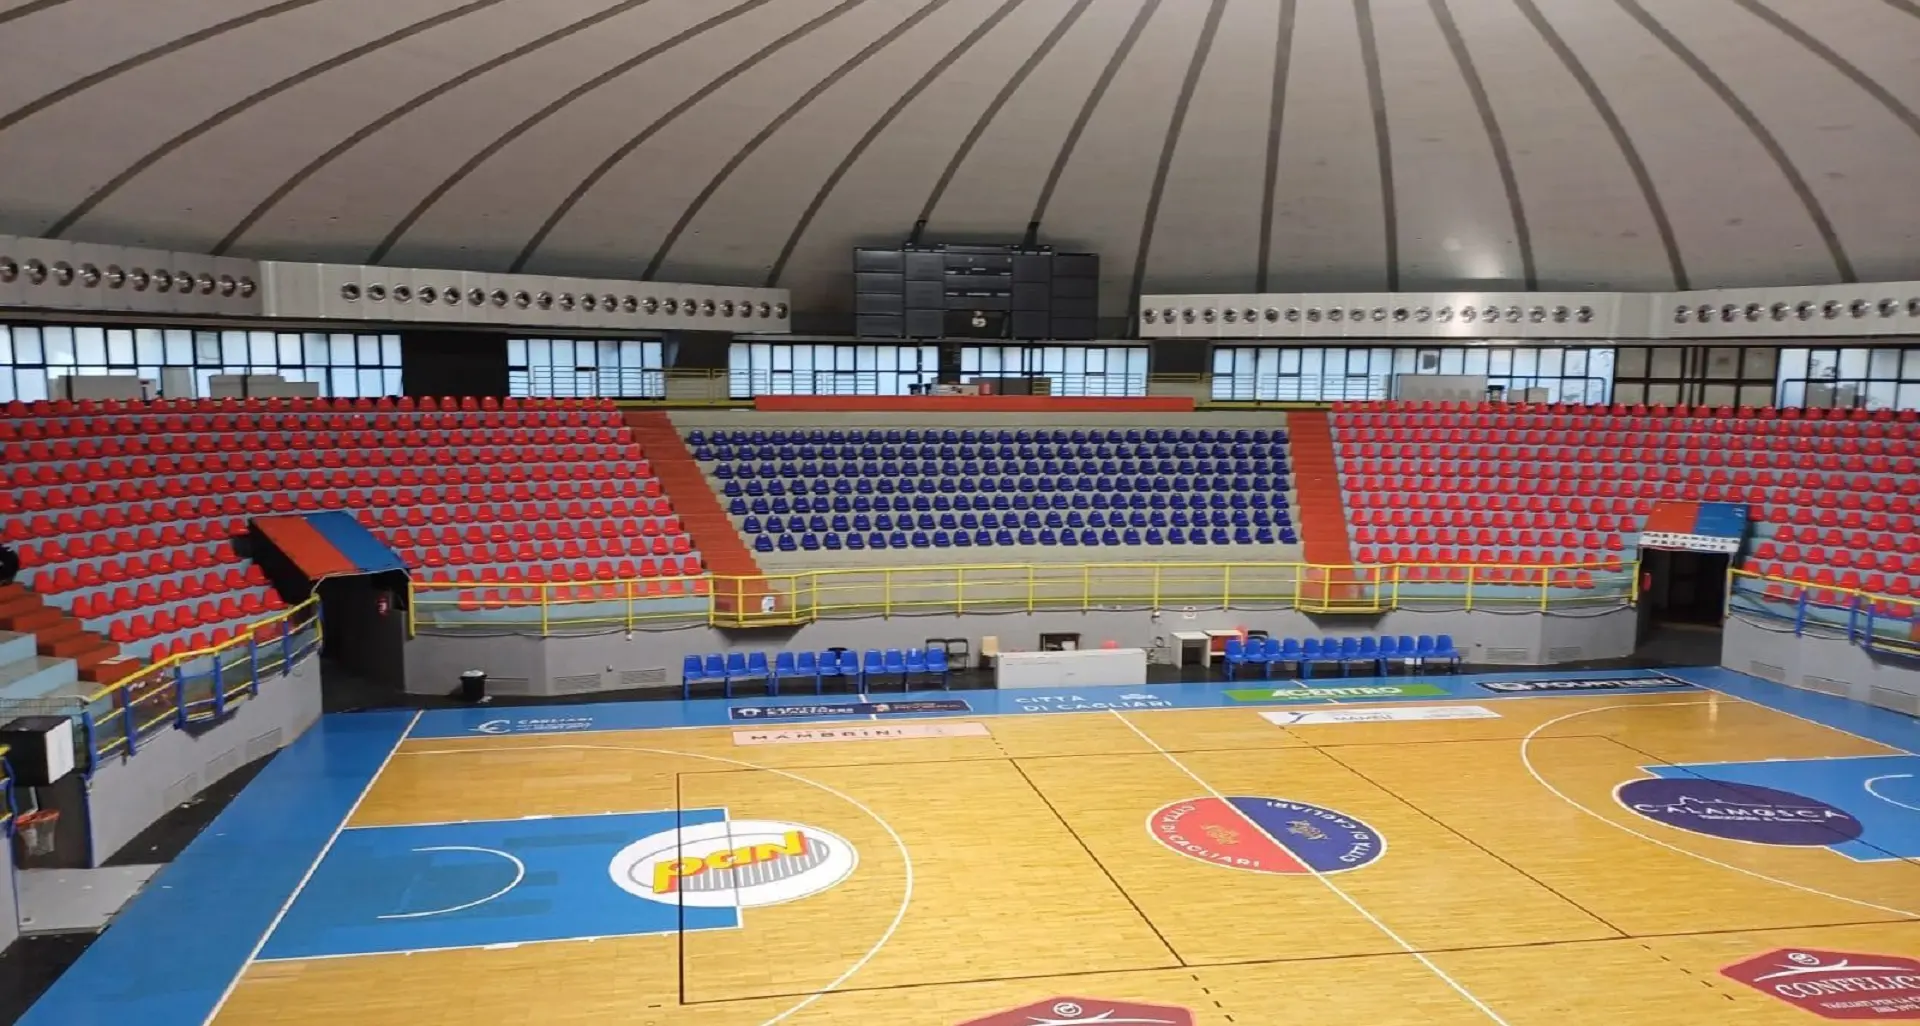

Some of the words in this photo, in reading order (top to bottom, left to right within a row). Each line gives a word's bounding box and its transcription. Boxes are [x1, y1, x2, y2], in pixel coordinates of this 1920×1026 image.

[1023, 704, 1049, 712] DI
[1057, 700, 1173, 710] CAGLIARI
[751, 729, 903, 741] MAMBRINI
[1267, 801, 1356, 829] CAGLIARI
[1633, 803, 1850, 821] CALAMOSCA
[1169, 835, 1260, 868] CAGLIARI
[1775, 976, 1920, 999] CONFELIC
